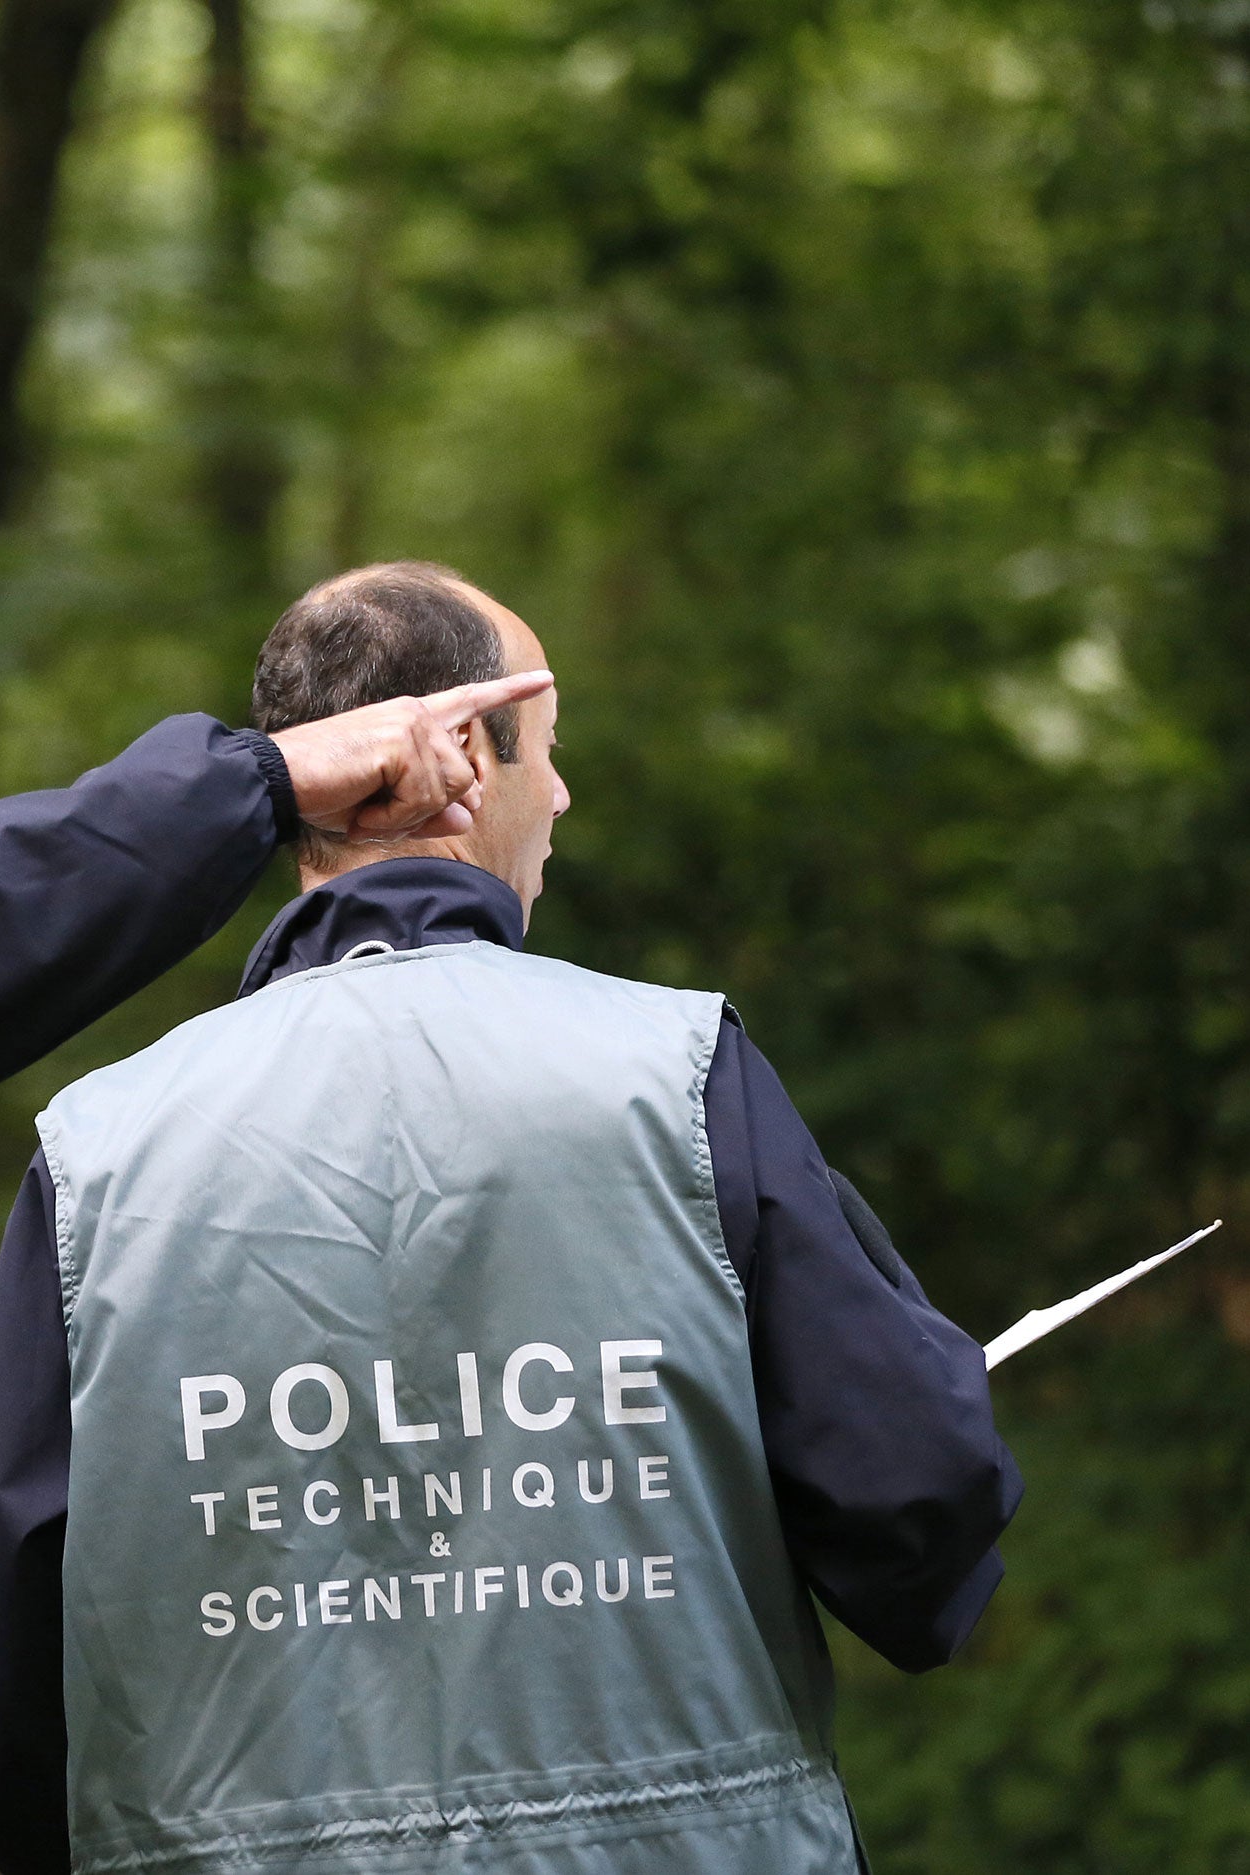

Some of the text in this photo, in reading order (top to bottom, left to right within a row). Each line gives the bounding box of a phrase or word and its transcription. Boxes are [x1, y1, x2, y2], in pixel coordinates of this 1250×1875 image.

[180, 1340, 667, 1461] POLICE
[190, 1455, 671, 1535] TECHNIQUE
[429, 1531, 452, 1557] &
[200, 1555, 675, 1637] SCIENTIFIQUE
